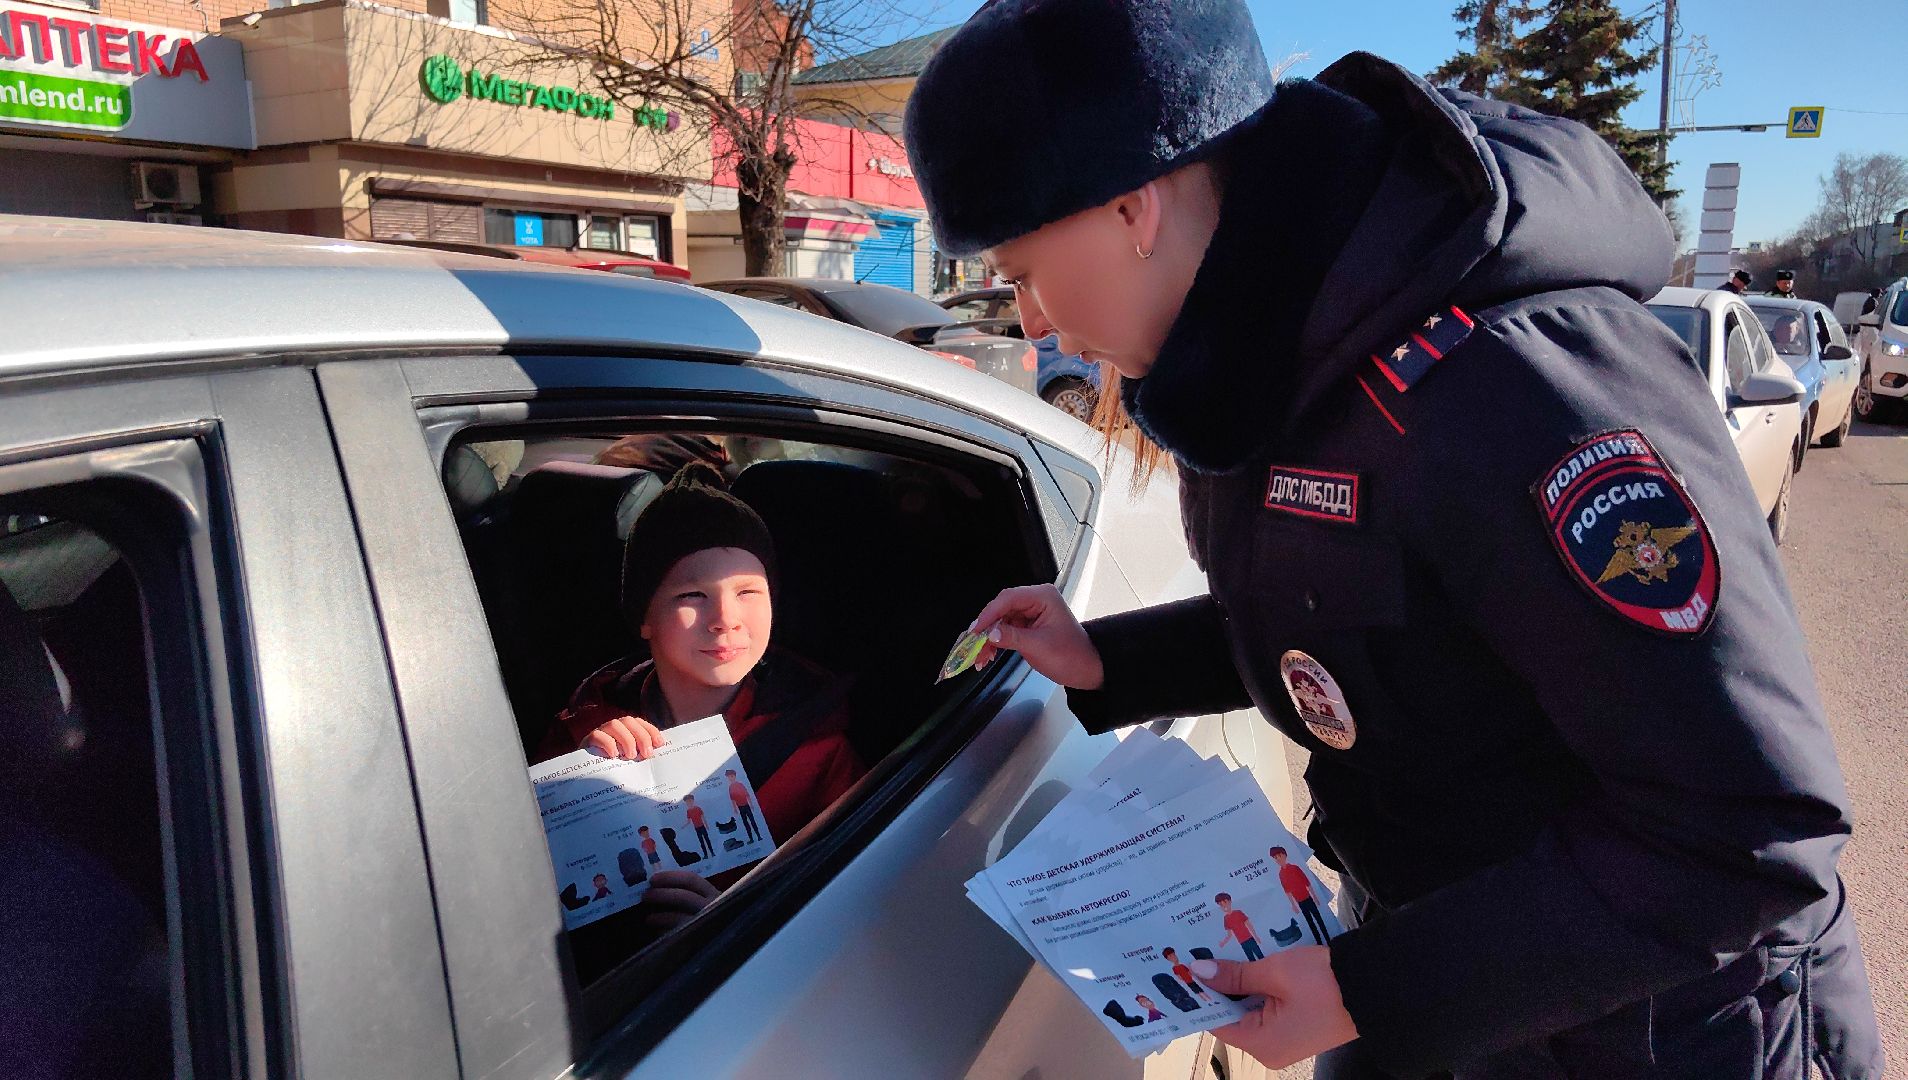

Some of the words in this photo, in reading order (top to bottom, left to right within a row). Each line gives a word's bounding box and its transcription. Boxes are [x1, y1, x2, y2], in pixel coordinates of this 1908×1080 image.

[0, 10, 209, 81] ПТЕКА
[467, 70, 614, 120] МЕГАФОН
[1269, 475, 1299, 502] ДПС
[1299, 480, 1351, 515] ГИБДД
[1547, 438, 1648, 504] ПОЛИЦИЯ
[1572, 482, 1665, 544] РОССИЯ
[1660, 593, 1707, 629] МВД
[1006, 879, 1022, 888] ЧТО
[1021, 872, 1046, 884] ТАКОЕ
[1046, 861, 1080, 878] ДЕТСКАЯ
[1079, 833, 1146, 866] УДЕРЖИВАЮЩАЯ
[1146, 814, 1186, 838] СИСТЕМА?
[1031, 917, 1046, 926] КАК
[1045, 908, 1080, 922] ВЫБРАТЬ
[1080, 889, 1131, 914] АВТОКРЕСЛО?
